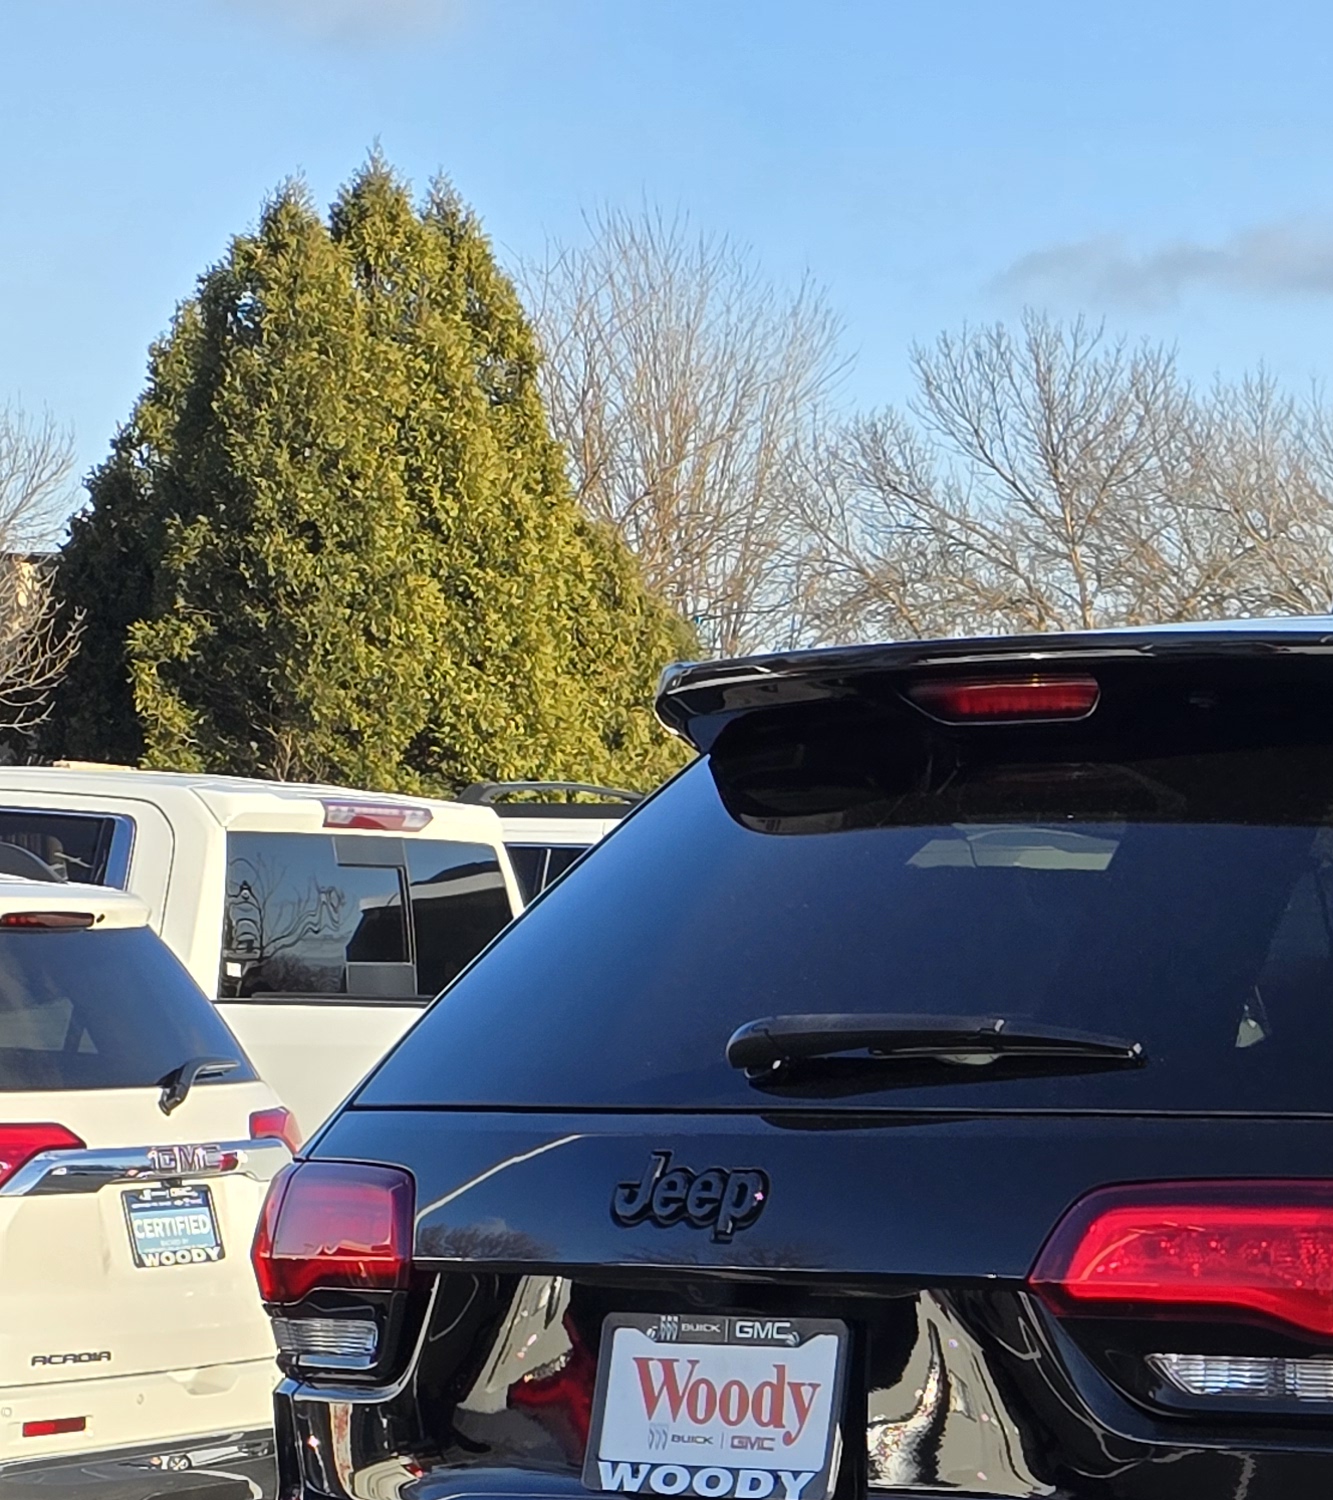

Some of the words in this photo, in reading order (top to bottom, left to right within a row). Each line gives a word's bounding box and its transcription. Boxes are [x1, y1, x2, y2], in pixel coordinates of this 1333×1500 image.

[611, 1149, 770, 1244] Jeep
[132, 1214, 212, 1240] CERTIFIED
[141, 1246, 221, 1267] WOODY
[681, 1323, 721, 1333] BUICK
[735, 1321, 791, 1340] GMC
[31, 1351, 111, 1367] ACADIA
[632, 1357, 822, 1447] Woody
[671, 1434, 713, 1445] BUICK
[730, 1435, 776, 1451] GMC
